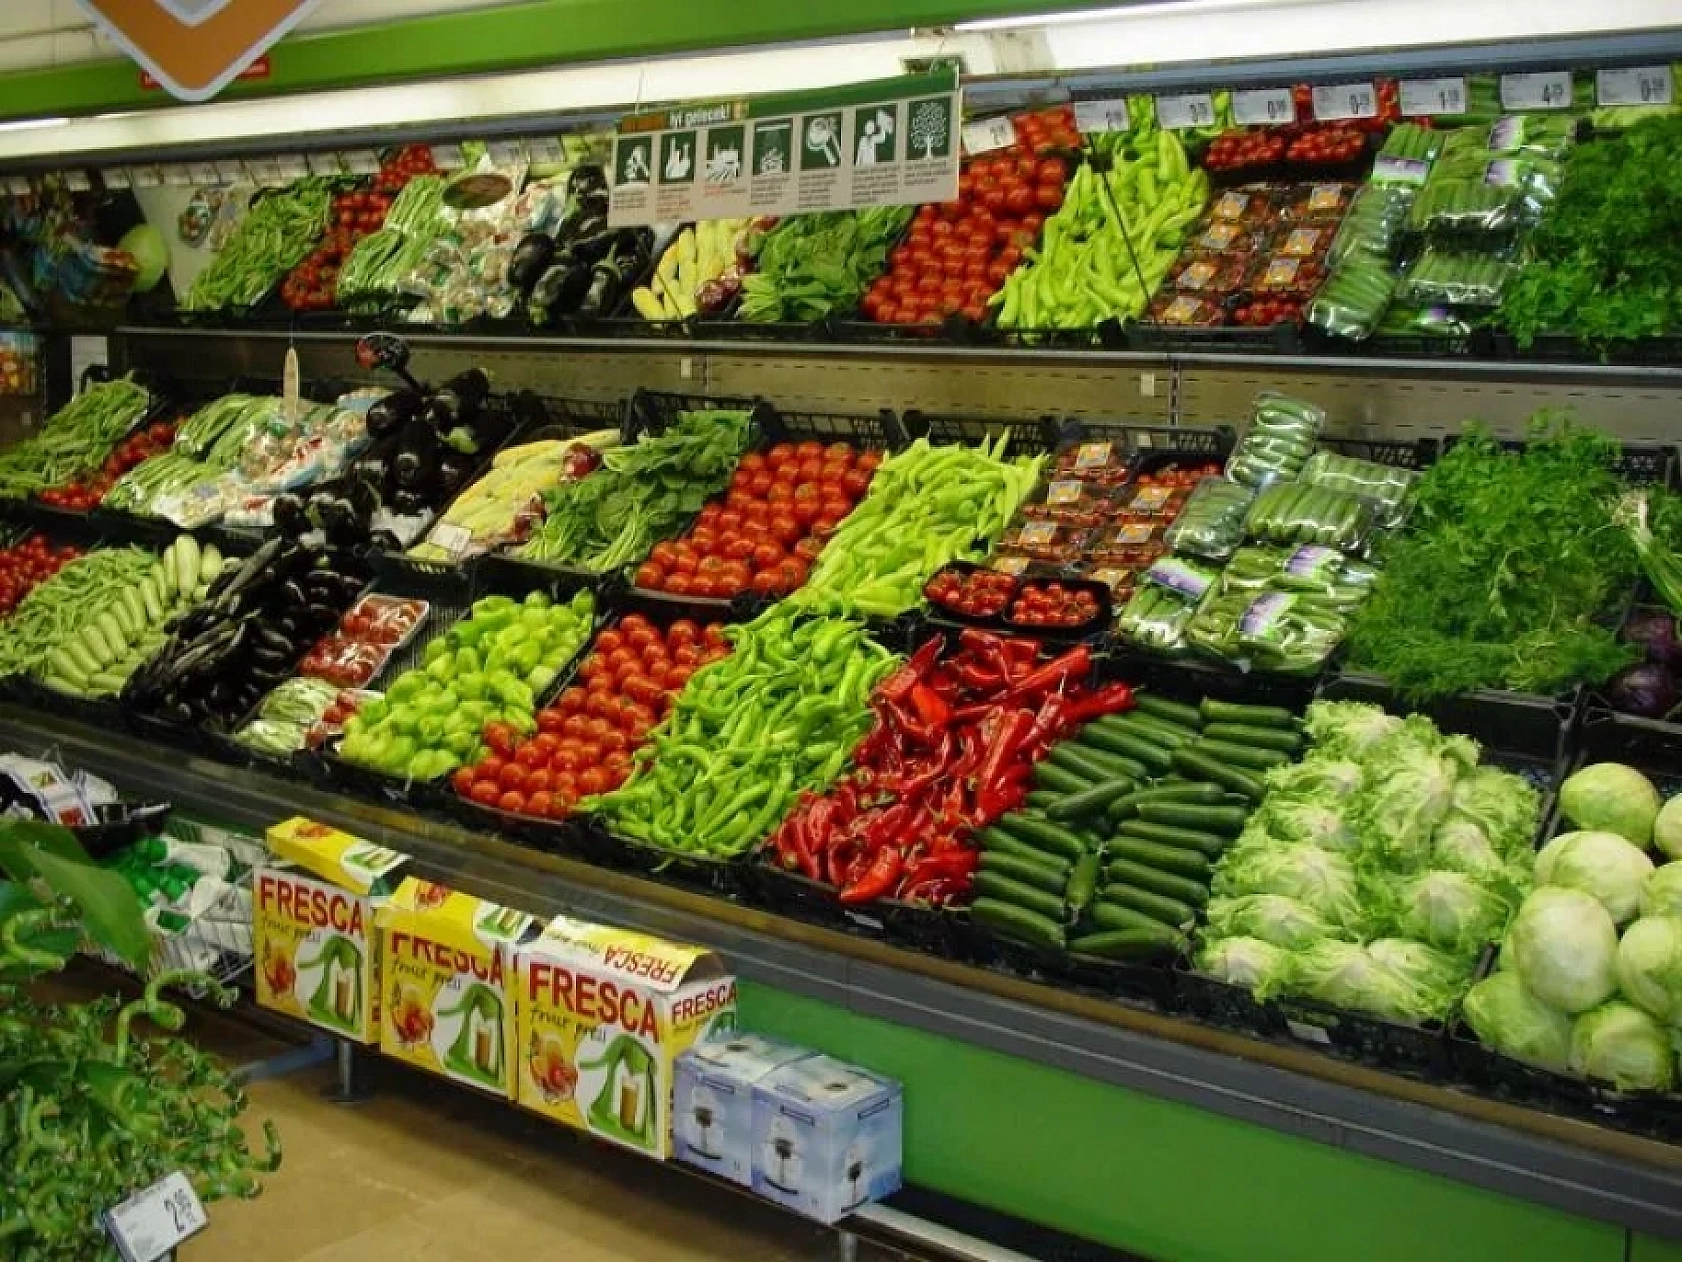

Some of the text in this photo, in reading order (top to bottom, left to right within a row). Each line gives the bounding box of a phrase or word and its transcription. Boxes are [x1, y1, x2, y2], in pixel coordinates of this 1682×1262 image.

[261, 875, 365, 941] FRESCA
[603, 944, 682, 983] FRESCA
[529, 963, 660, 1043] FRESCA
[672, 980, 737, 1026] FRESCA
